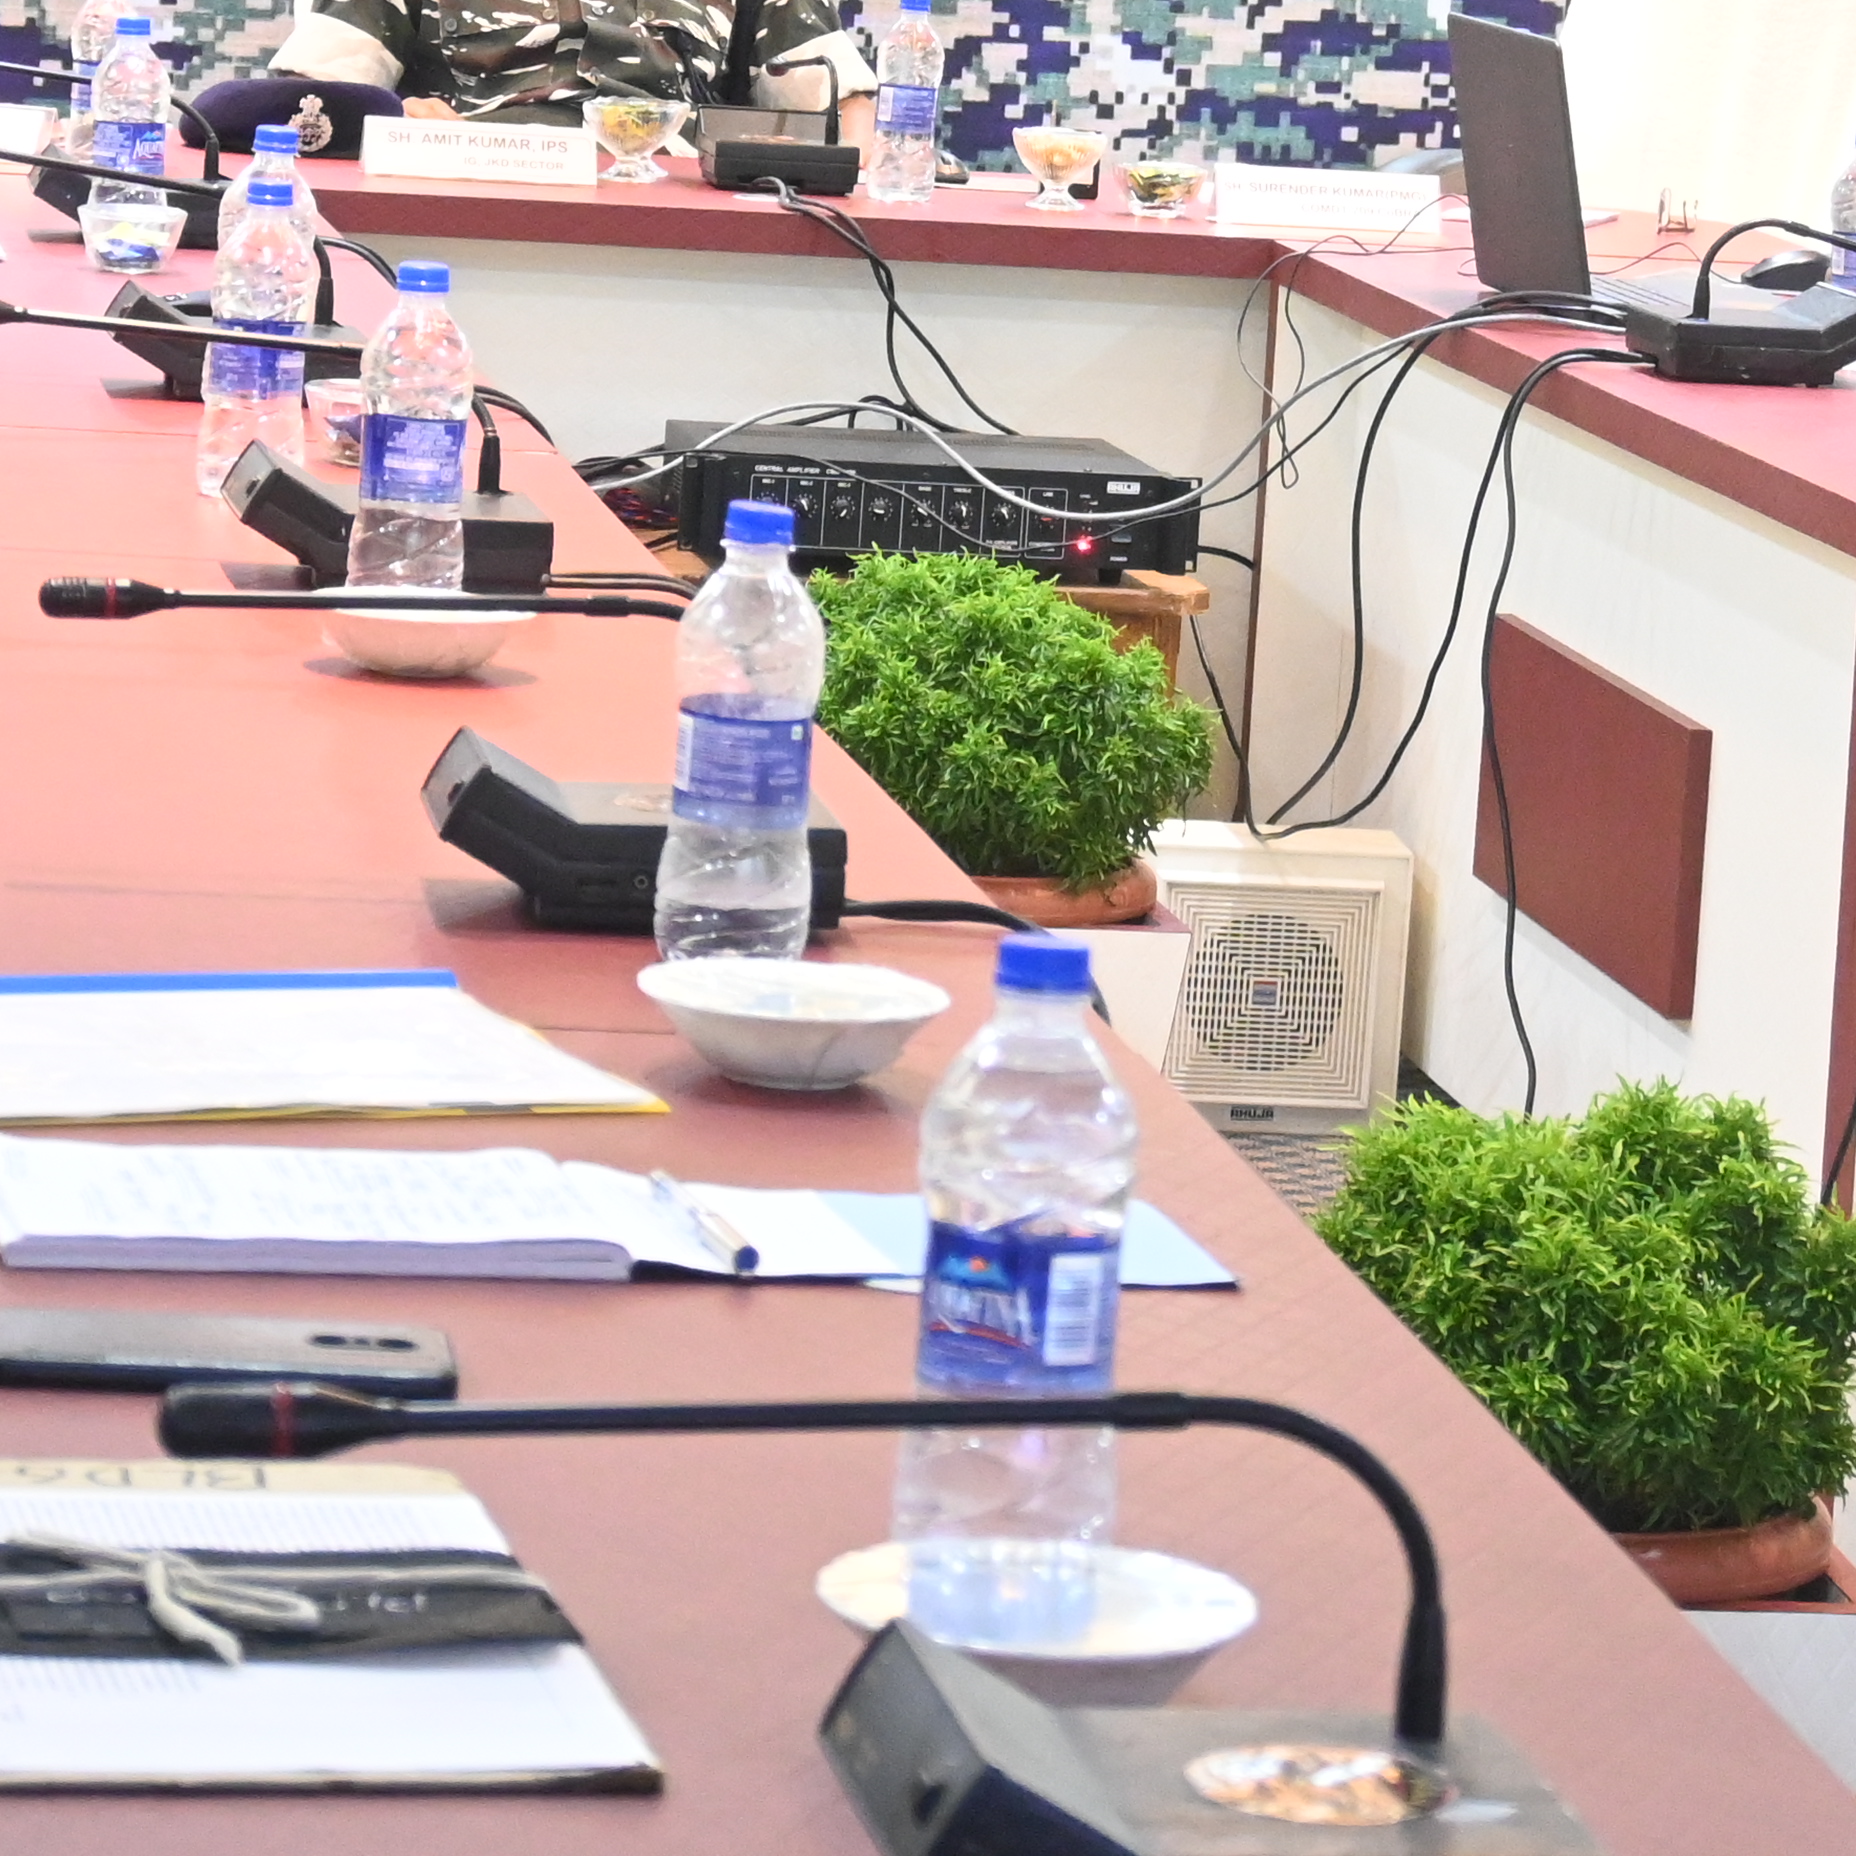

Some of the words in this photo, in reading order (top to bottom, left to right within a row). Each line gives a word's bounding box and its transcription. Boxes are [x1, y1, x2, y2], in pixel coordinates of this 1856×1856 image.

[421, 133, 463, 146] AMIT
[468, 136, 536, 153] KUMAR,
[542, 140, 569, 153] IPS
[512, 159, 564, 170] SECTOR
[1249, 181, 1328, 195] SURENDER
[1230, 1108, 1275, 1120] AHUJA
